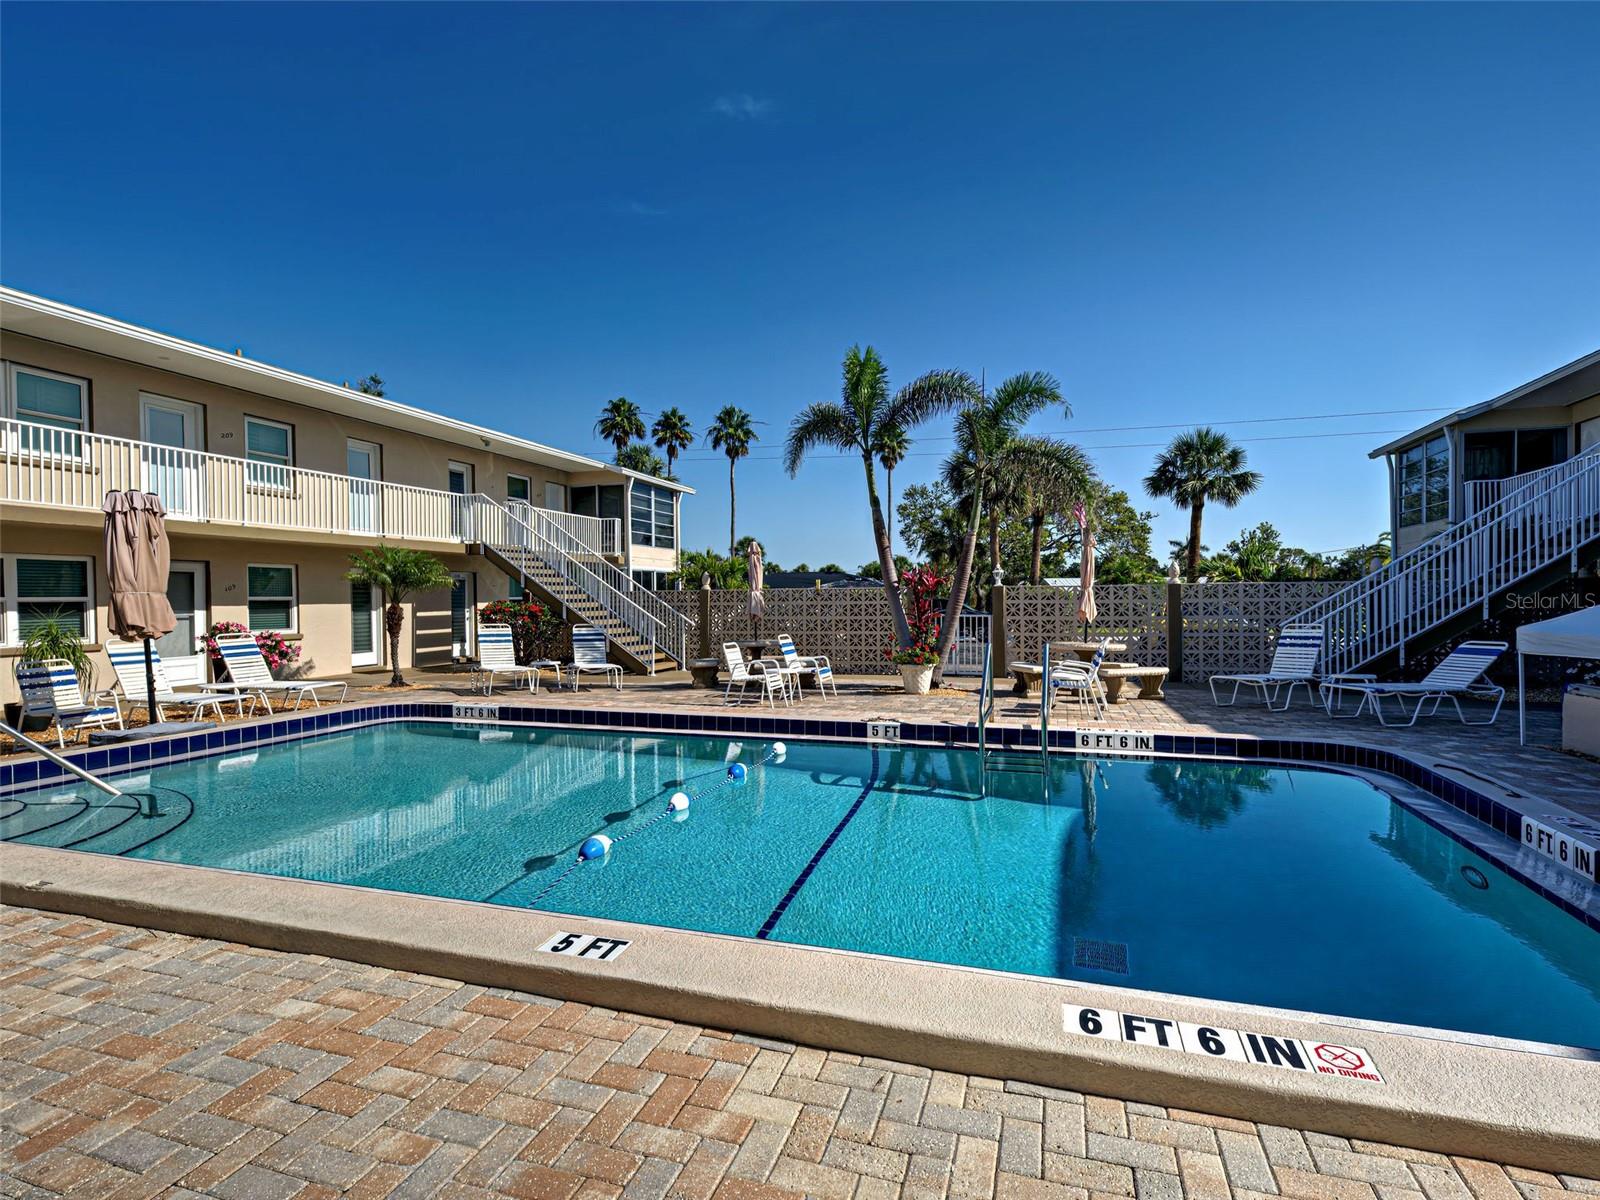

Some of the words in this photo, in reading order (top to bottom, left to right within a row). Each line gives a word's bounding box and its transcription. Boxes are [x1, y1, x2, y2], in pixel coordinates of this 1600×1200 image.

[455, 706, 461, 717] 3
[478, 708, 484, 718] 6
[871, 725, 879, 737] 5
[1081, 734, 1090, 747] 6
[1096, 735, 1113, 748] FT.
[1119, 736, 1128, 748] 6
[1135, 736, 1153, 750] IN.
[1525, 823, 1533, 843] 6
[1537, 828, 1553, 855] FT.
[1559, 839, 1568, 862] 6
[1574, 846, 1593, 876] IN.
[550, 933, 582, 953] 5
[577, 937, 630, 960] FT
[1078, 1008, 1103, 1035] 6
[1122, 1013, 1173, 1047] FT
[1197, 1026, 1226, 1056] 6
[1246, 1033, 1307, 1070] IN
[1317, 1065, 1336, 1075] NO
[1338, 1068, 1381, 1082] DIVING
